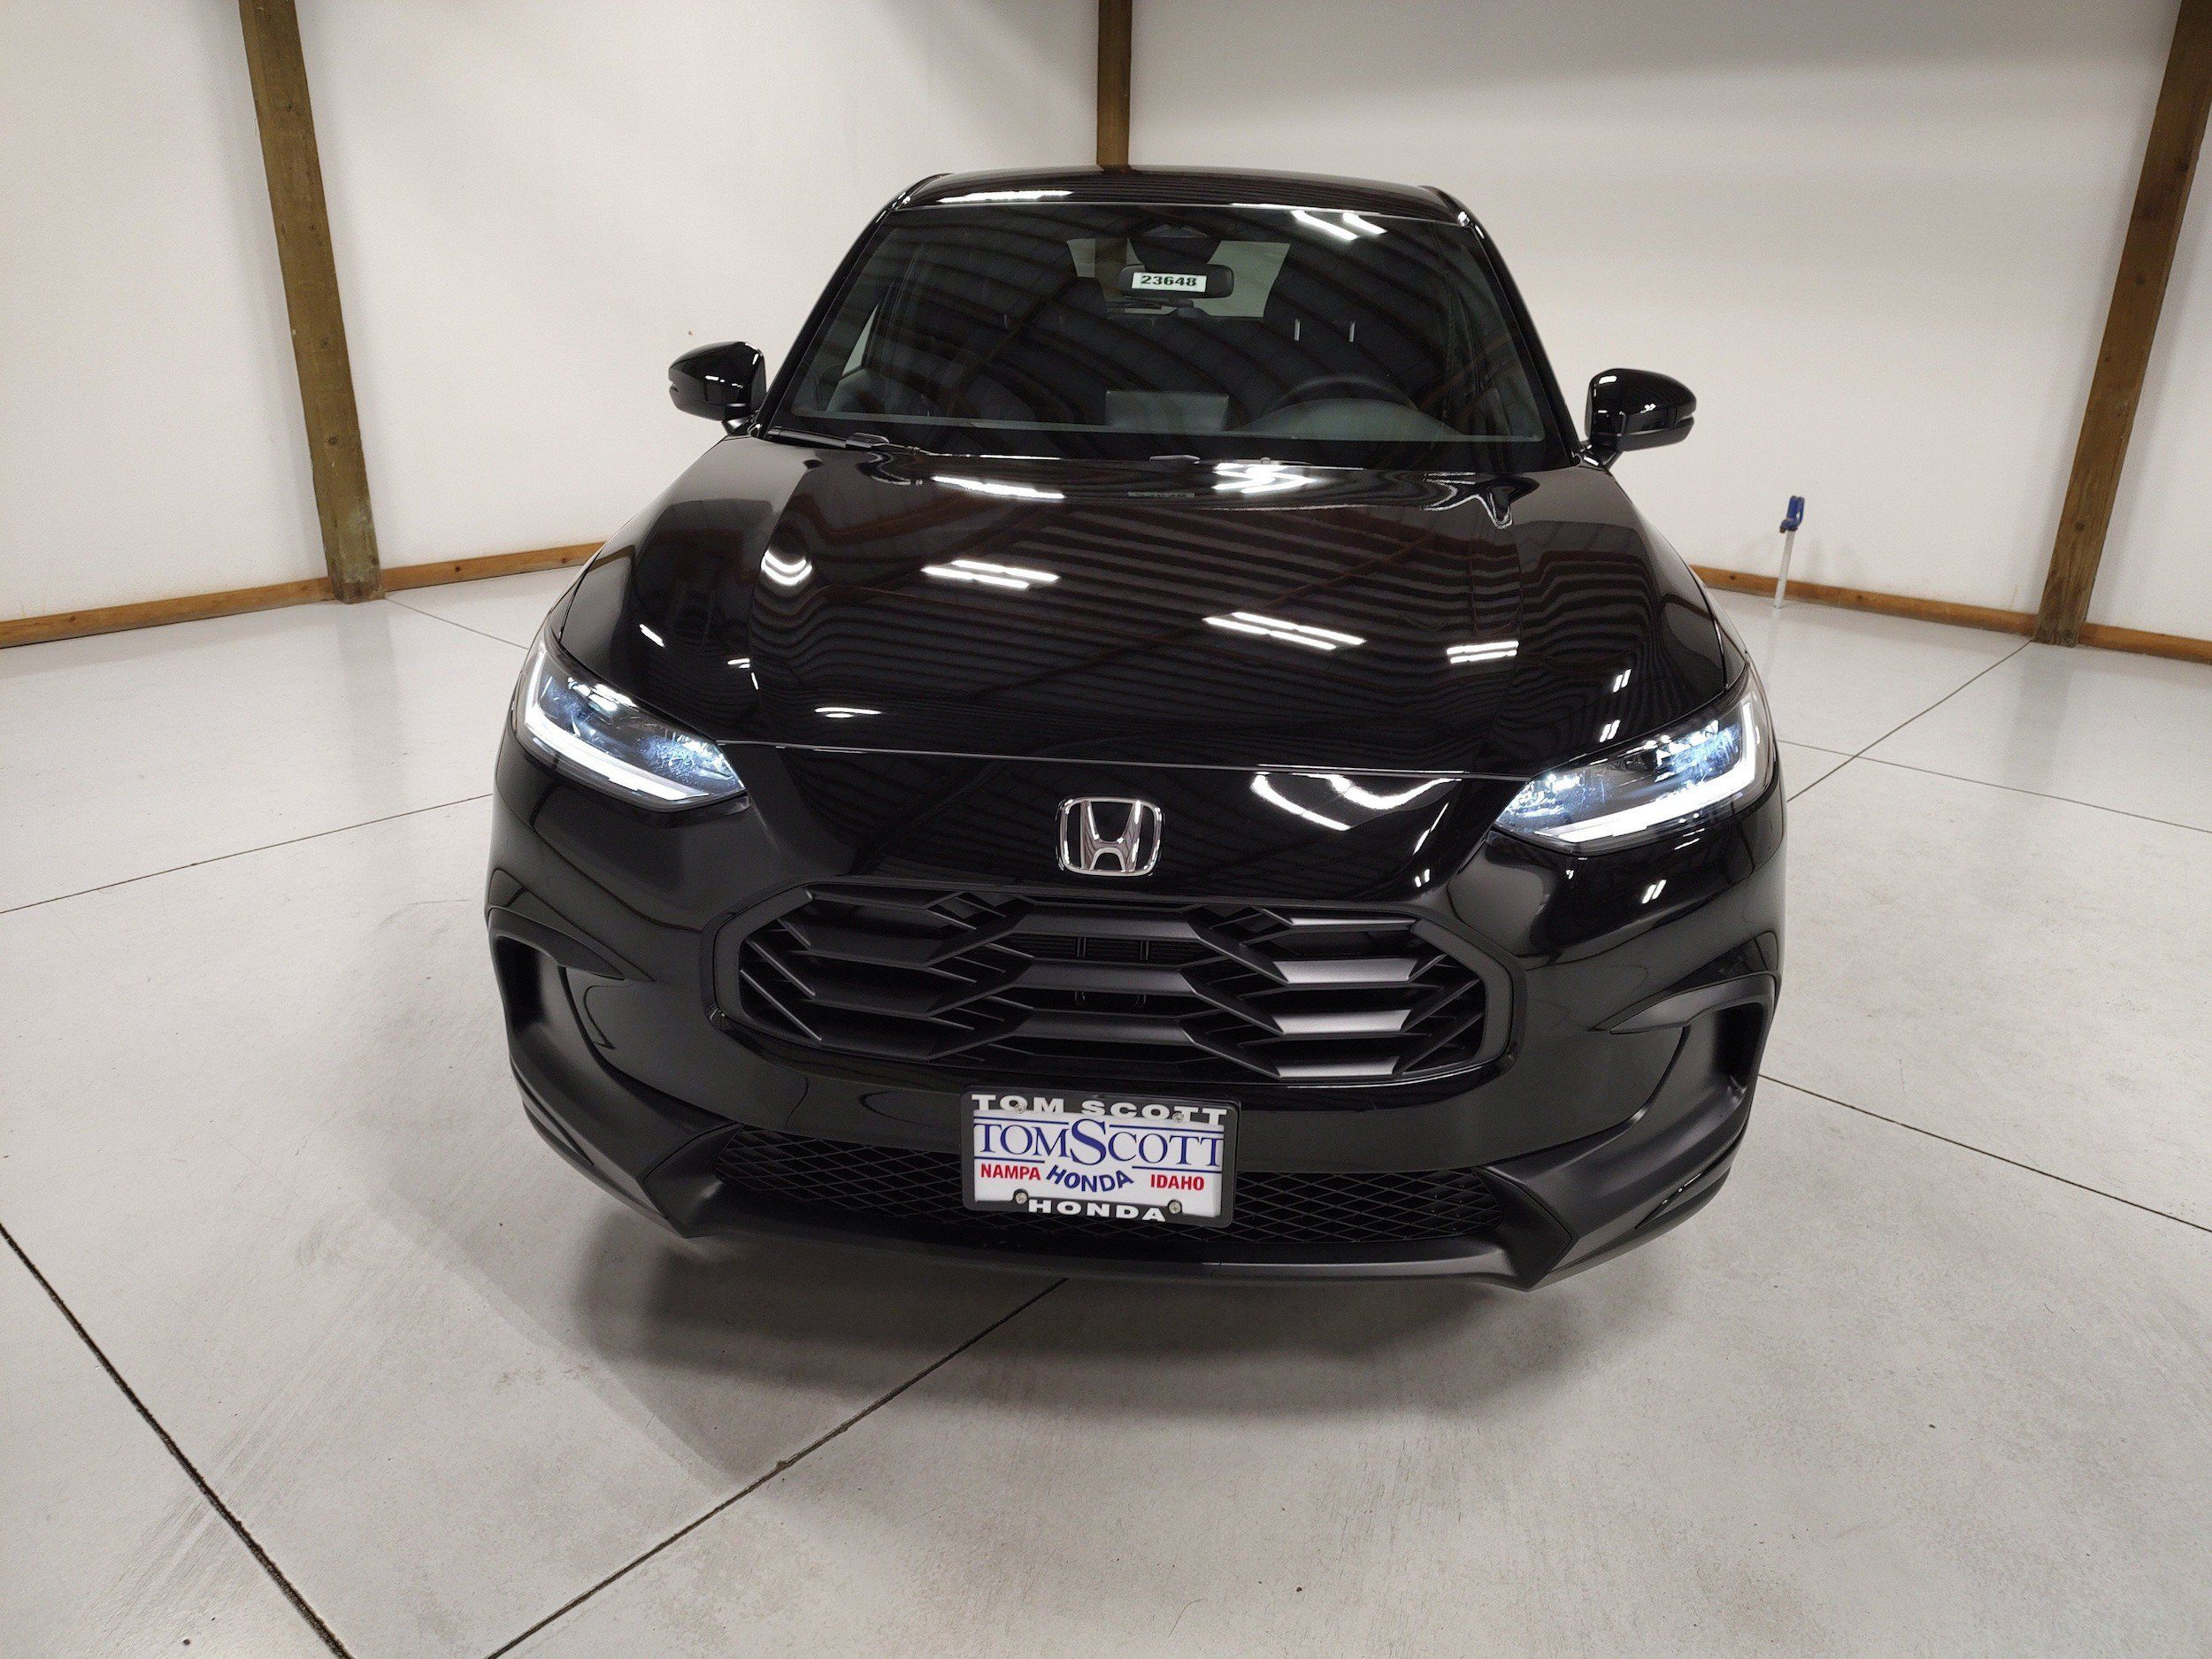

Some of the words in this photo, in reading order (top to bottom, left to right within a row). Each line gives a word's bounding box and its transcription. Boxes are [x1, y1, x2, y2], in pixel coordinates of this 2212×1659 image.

[1141, 275, 1196, 286] 23648
[972, 1094, 1064, 1113] TOM
[1081, 1100, 1227, 1125] SCOTT
[980, 1164, 1041, 1180] NAMPA
[1046, 1164, 1134, 1192] HONDA
[1150, 1174, 1204, 1191] IDAHO
[1028, 1199, 1166, 1222] HONDA
